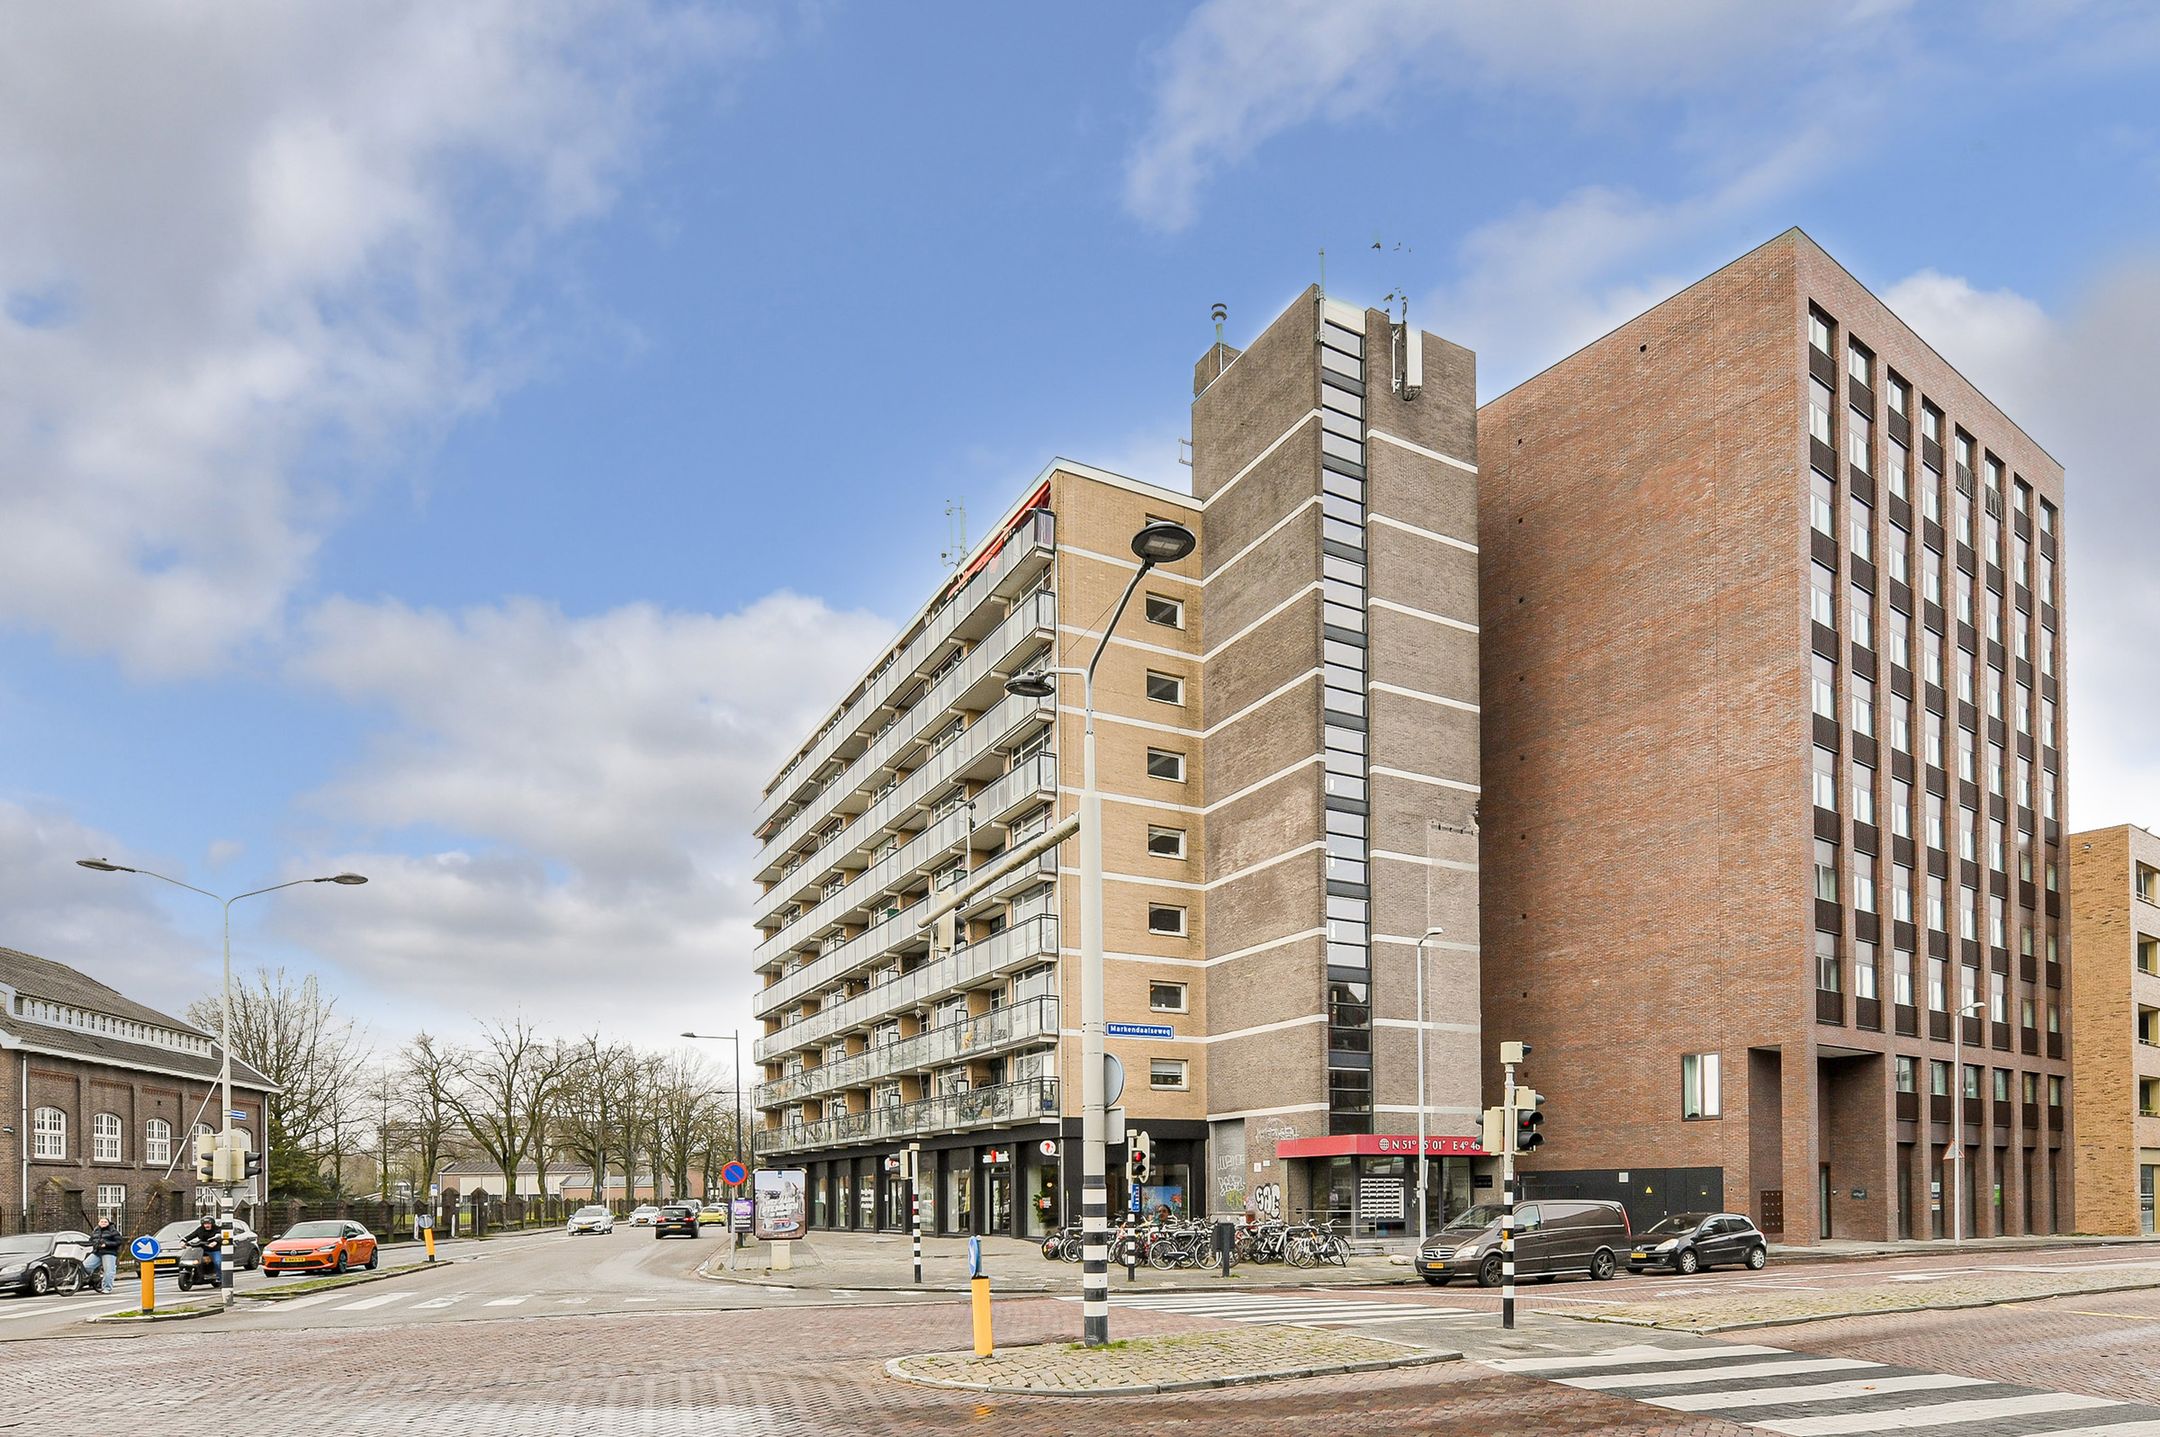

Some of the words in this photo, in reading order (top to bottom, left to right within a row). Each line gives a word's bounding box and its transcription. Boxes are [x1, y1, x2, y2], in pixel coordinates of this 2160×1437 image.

[1110, 1025, 1170, 1036] Markendaalseweg
[1391, 1140, 1400, 1150] N
[1453, 1140, 1458, 1150] E
